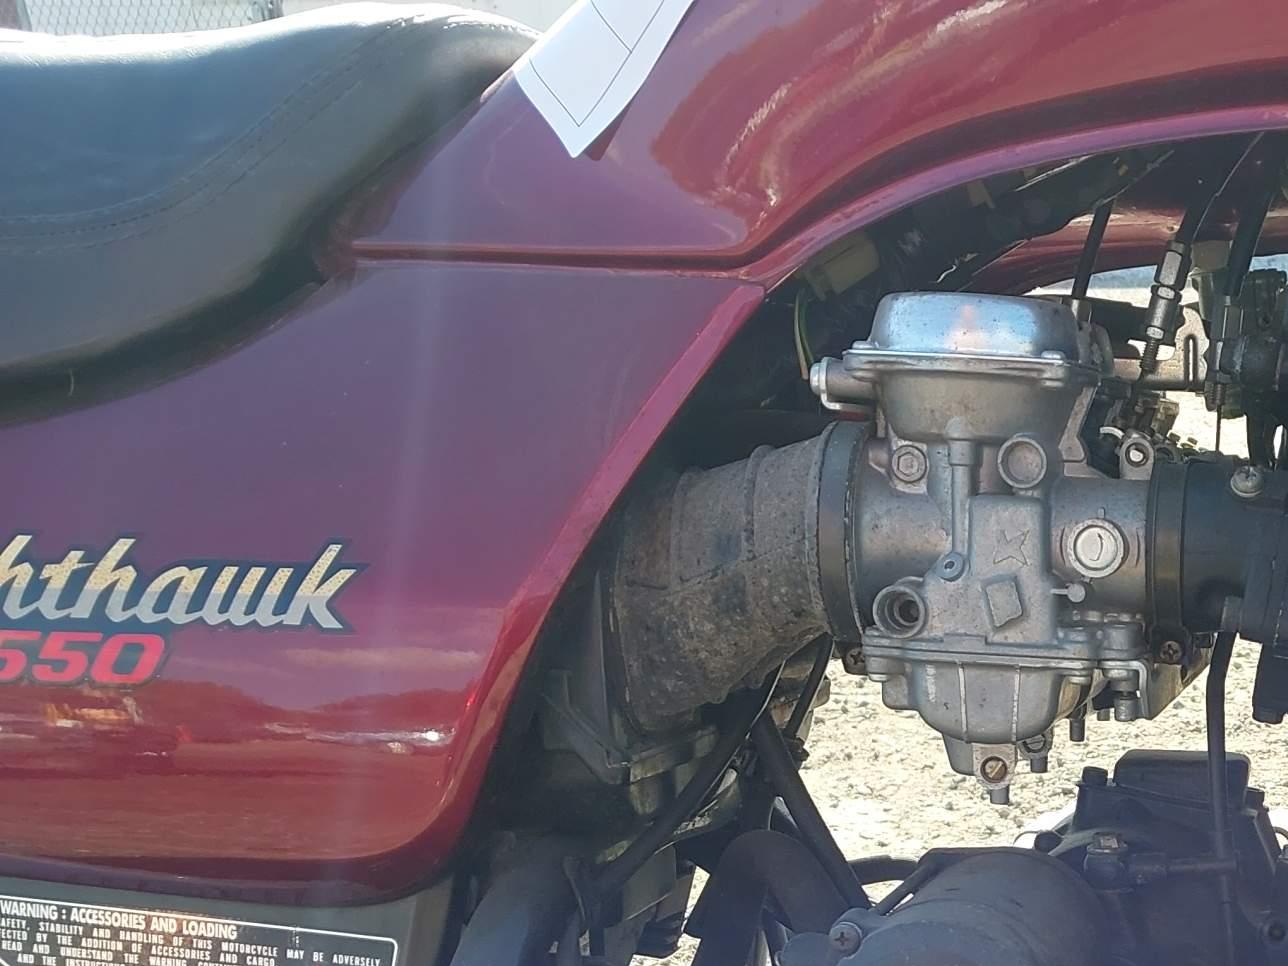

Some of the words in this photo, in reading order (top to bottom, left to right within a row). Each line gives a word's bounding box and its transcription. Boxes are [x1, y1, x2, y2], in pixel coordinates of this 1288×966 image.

[1, 900, 58, 920] WARNING
[70, 907, 146, 930] ACCESSORIES
[150, 916, 177, 934] AND
[182, 919, 237, 940] LOADING
[0, 927, 28, 941] ECTED
[36, 932, 47, 942] BY
[57, 934, 72, 946] THE
[81, 937, 123, 951] ADDITION
[131, 942, 142, 953] OF
[151, 945, 210, 961] ACCESSORIES
[219, 952, 237, 964] AND
[2, 940, 22, 951] READ
[32, 943, 50, 954] AND
[60, 946, 113, 961] UNDERSTAND
[123, 952, 139, 964] THE
[17, 953, 34, 964] AND
[42, 955, 56, 966] THE
[39, 921, 83, 935] STABILITY
[92, 927, 111, 938] AND
[119, 930, 164, 944] HANDLING
[172, 936, 183, 946] OF
[192, 938, 212, 950] THIS
[221, 941, 278, 957] MOTORCYCLE
[286, 948, 304, 959] MAY
[312, 951, 323, 962] BE
